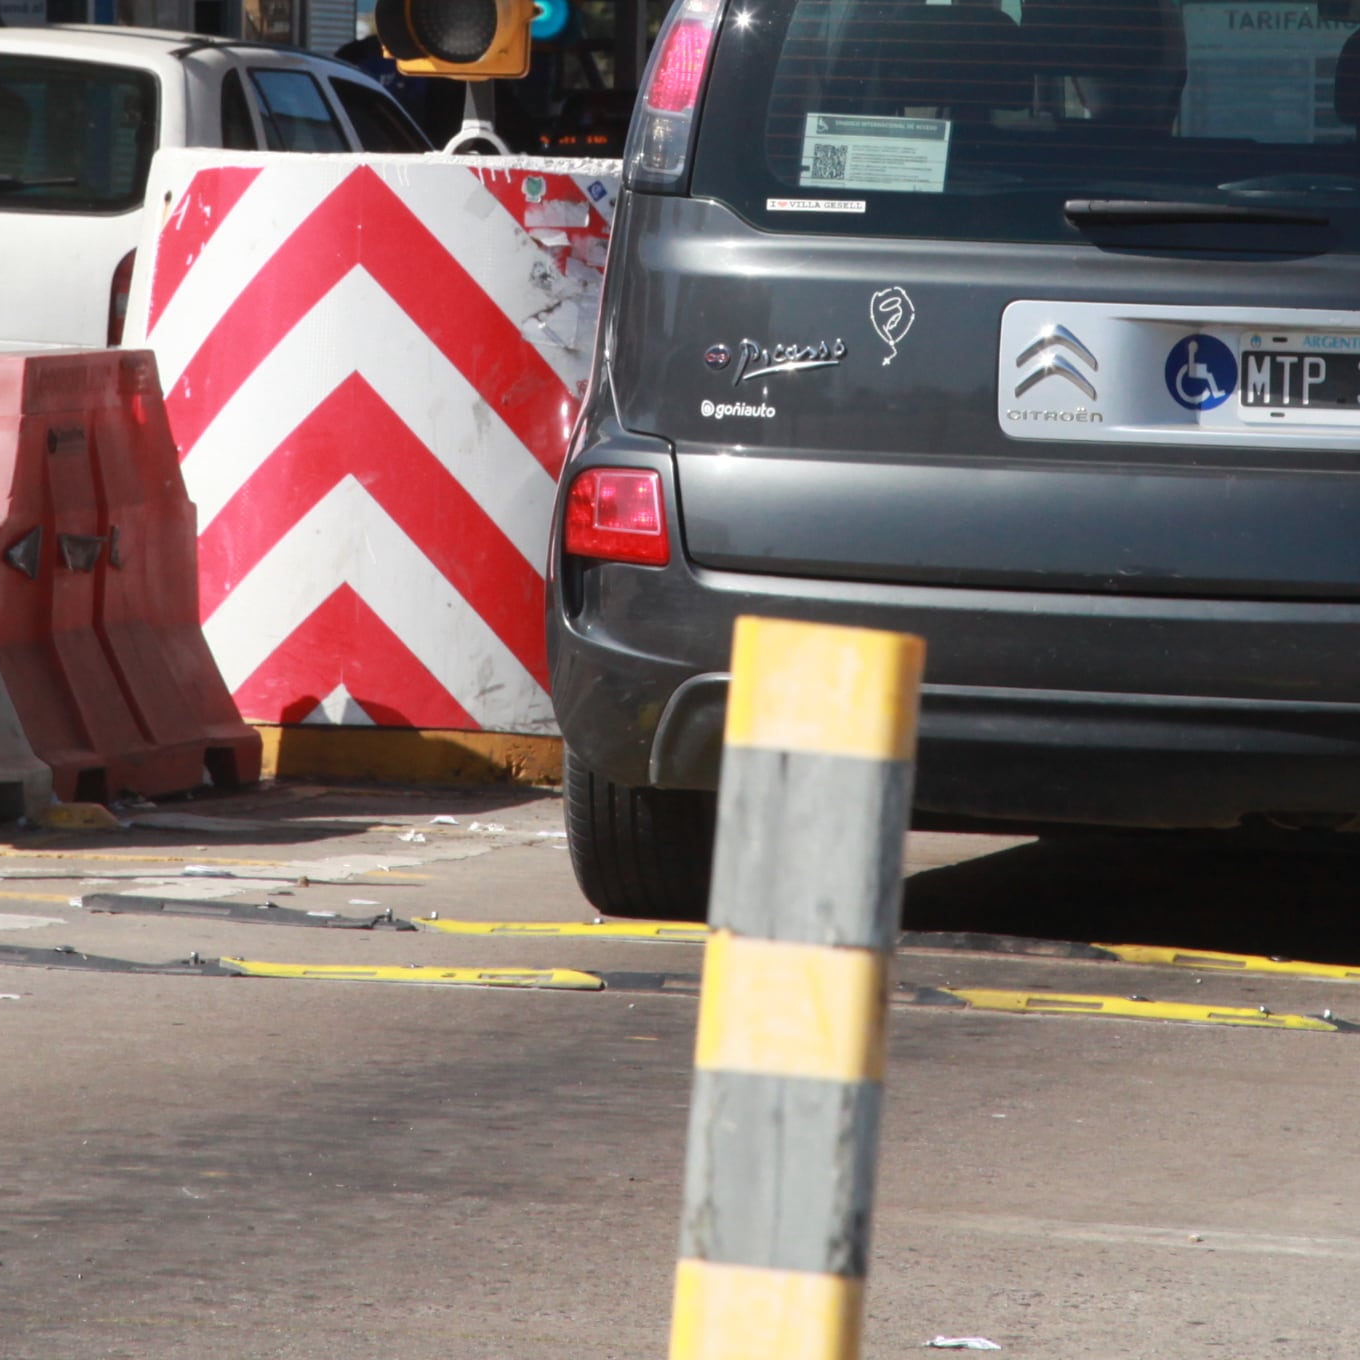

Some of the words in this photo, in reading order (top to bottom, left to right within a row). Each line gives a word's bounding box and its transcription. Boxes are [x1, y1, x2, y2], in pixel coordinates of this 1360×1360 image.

[789, 200, 822, 208] VILLA
[823, 201, 863, 210] GESELL
[733, 337, 847, 387] Picasso
[1247, 355, 1326, 405] MTP
[701, 399, 776, 420] @goñiauto
